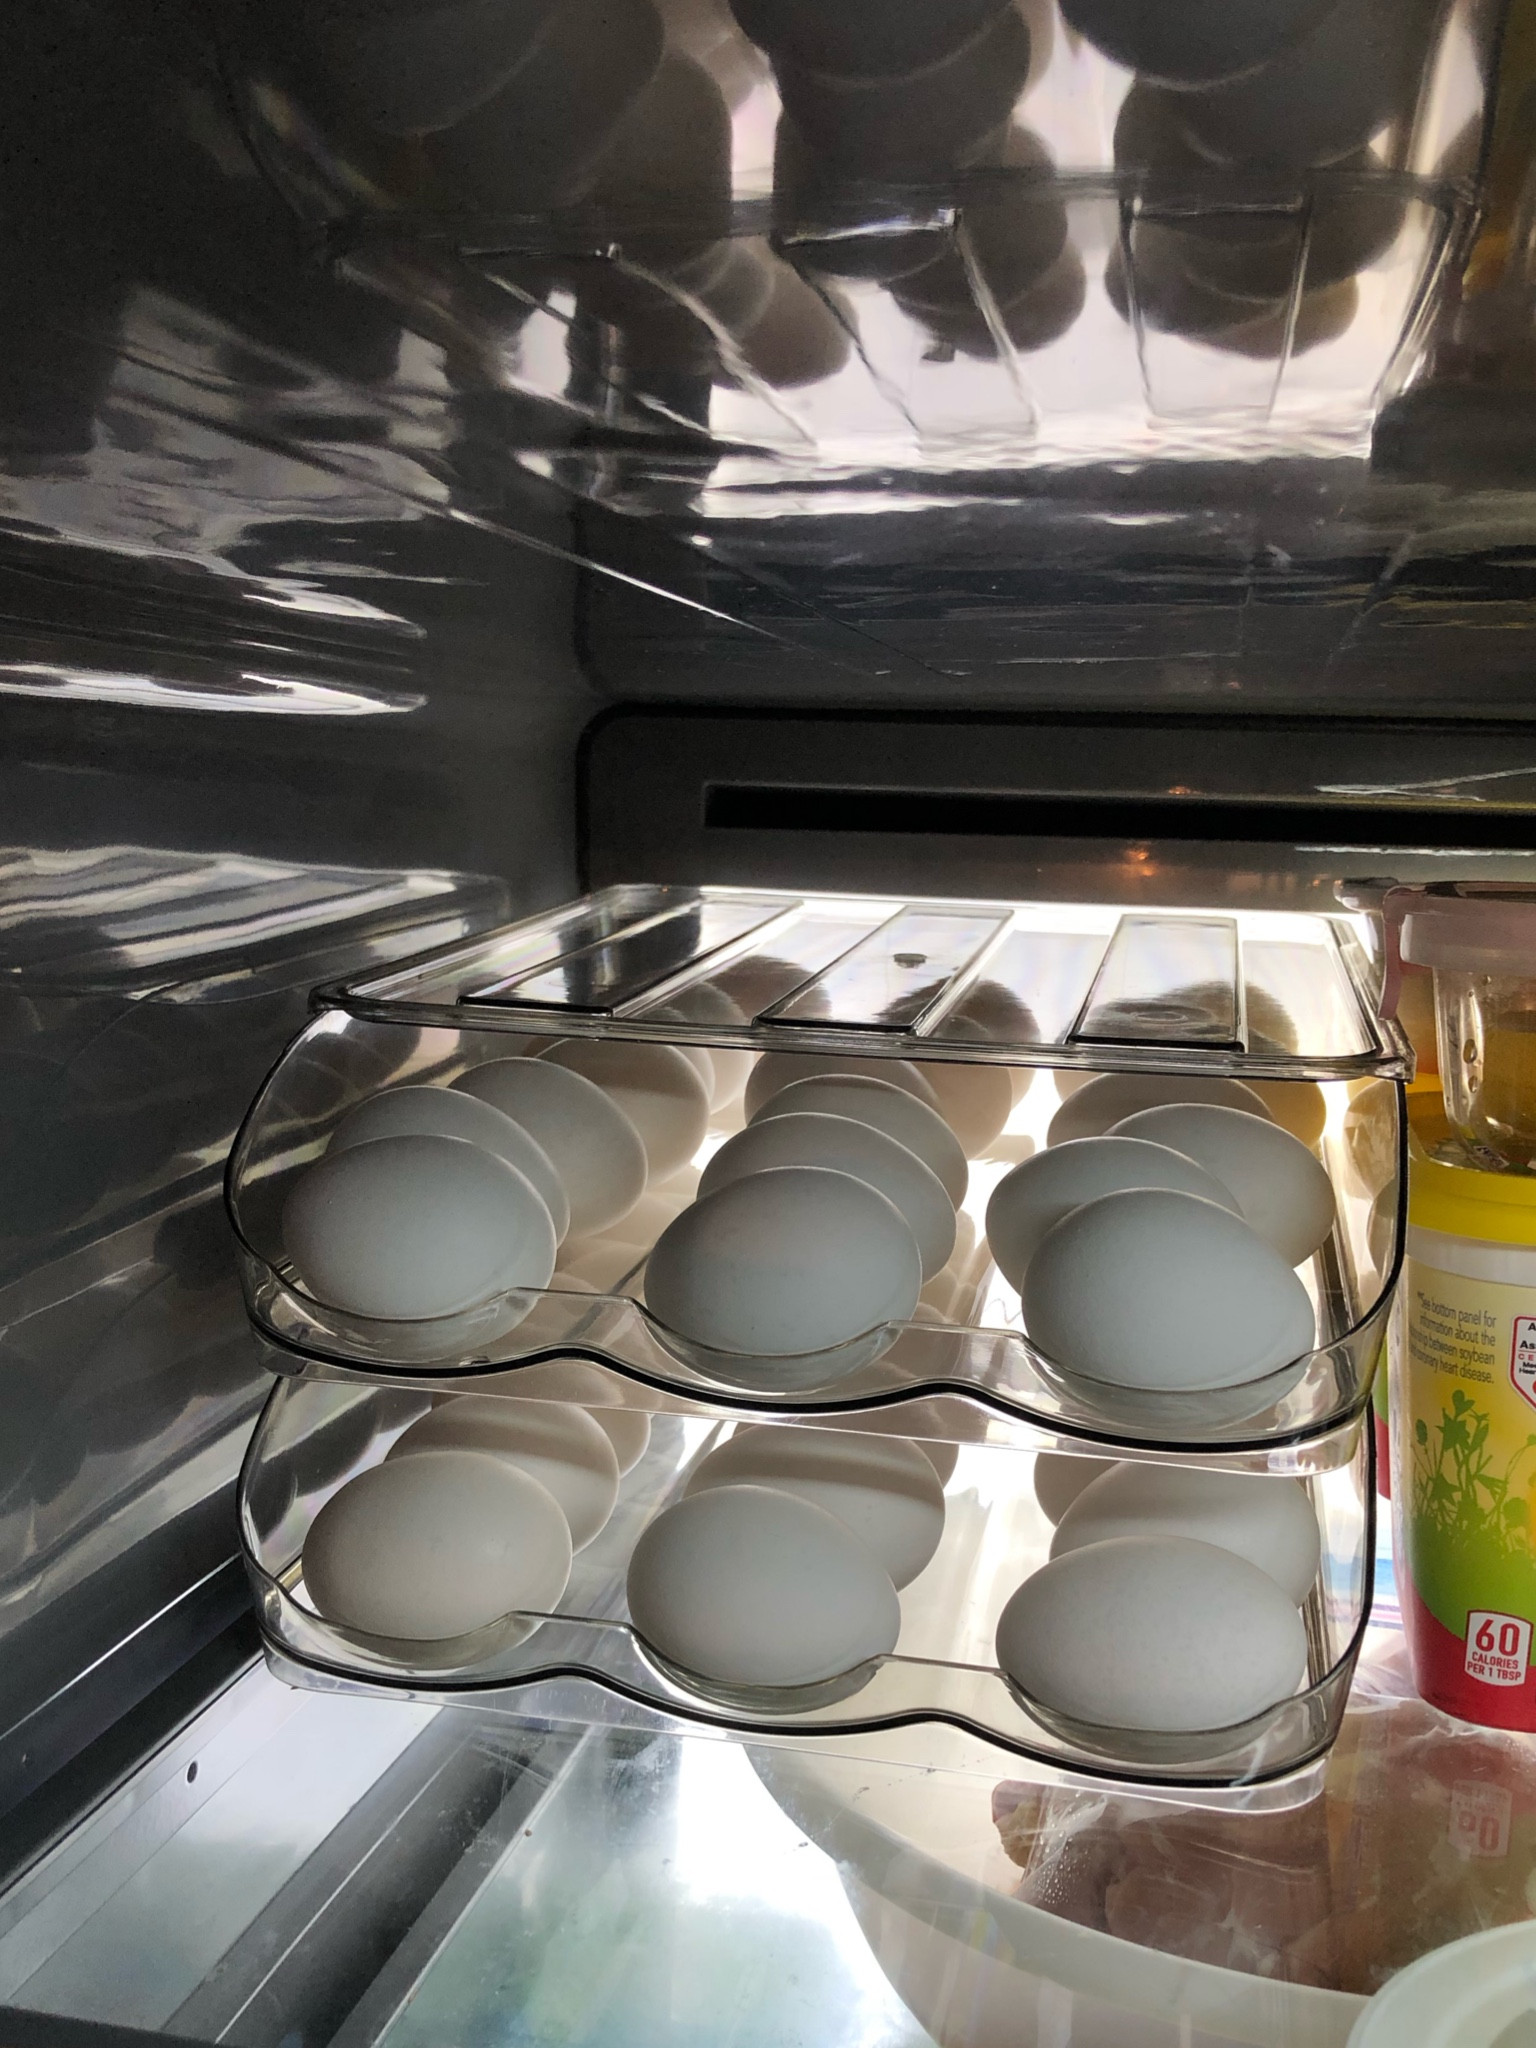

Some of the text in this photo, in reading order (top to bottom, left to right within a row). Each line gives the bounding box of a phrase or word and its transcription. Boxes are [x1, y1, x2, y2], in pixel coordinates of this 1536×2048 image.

[1431, 1297, 1456, 1319] bottom
[1458, 1309, 1481, 1328] panel
[1484, 1310, 1496, 1328] for
[1455, 1324, 1479, 1344] about
[1481, 1329, 1495, 1347] the
[1429, 1334, 1457, 1356] between
[1459, 1346, 1495, 1366] soybean
[1440, 1357, 1459, 1376] heart
[1460, 1363, 1494, 1384] disease.
[1475, 1618, 1520, 1657] 60
[1466, 1661, 1521, 1681] PER 1 TBSP
[1471, 1651, 1519, 1669] CALORIES
